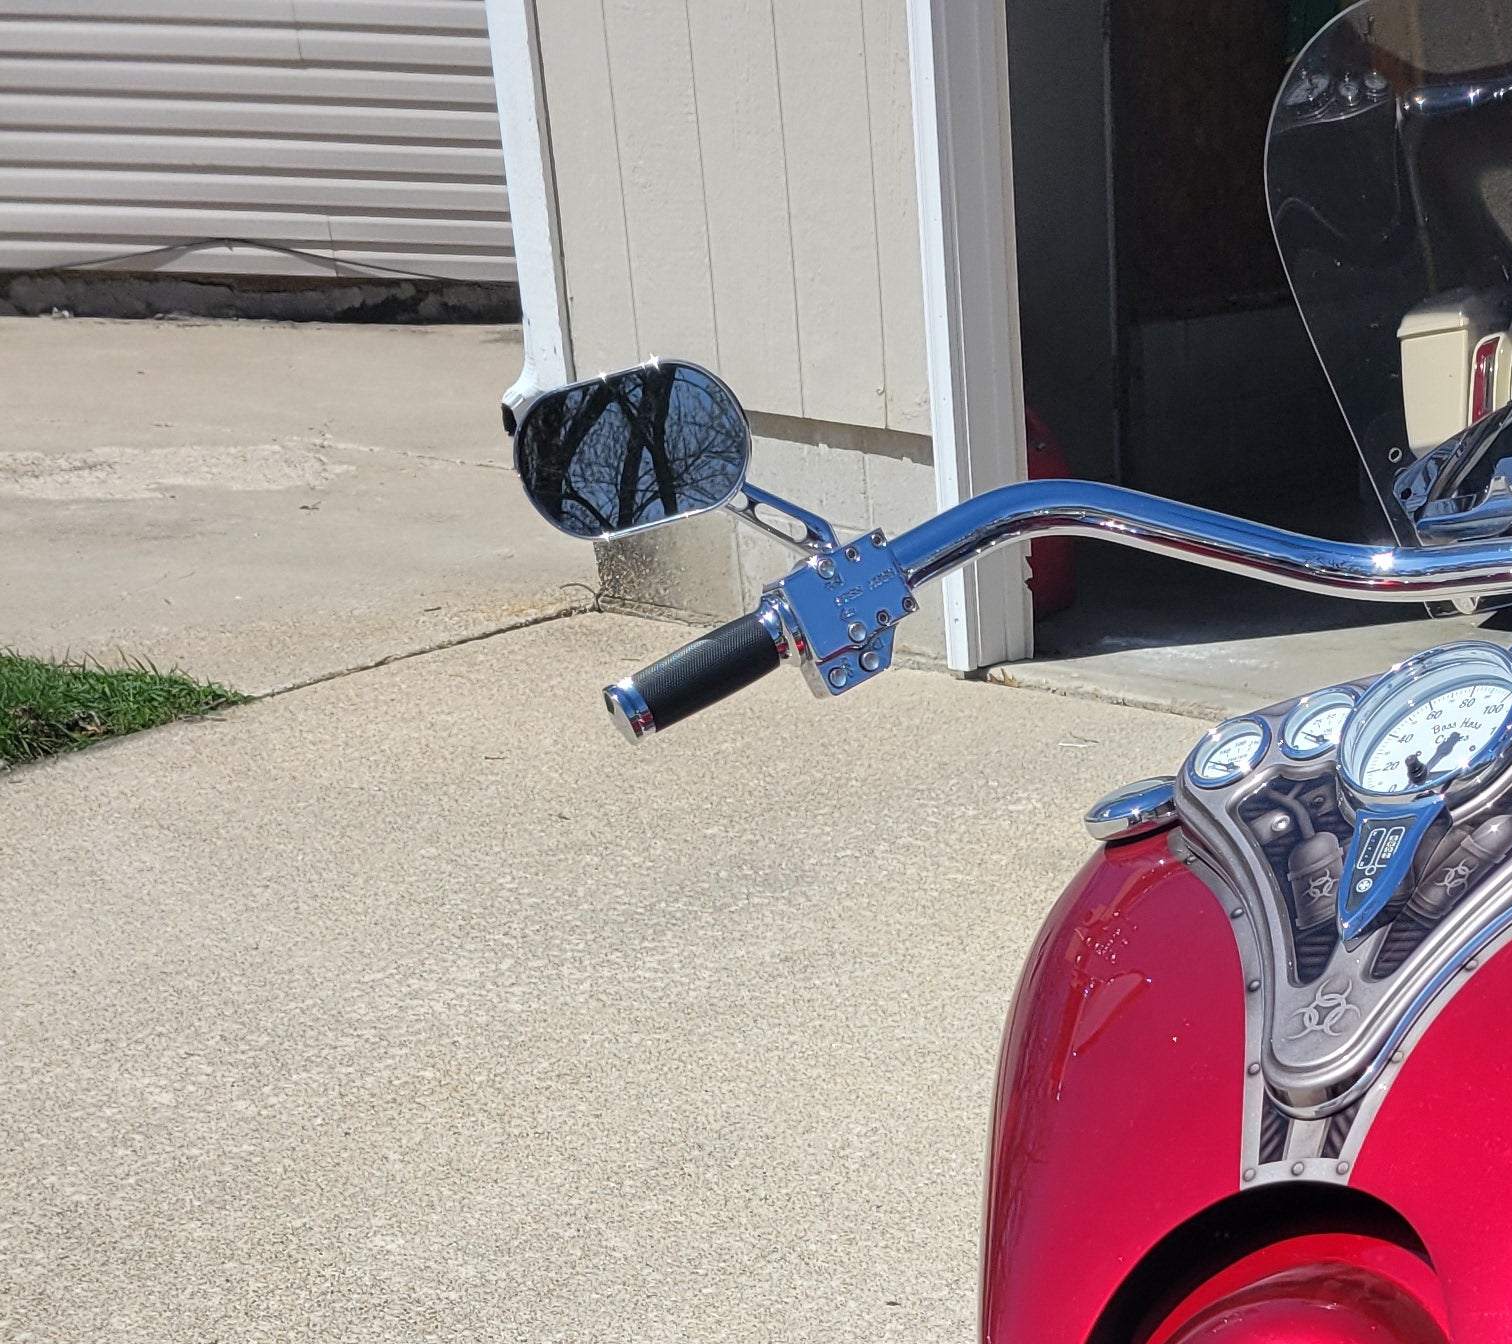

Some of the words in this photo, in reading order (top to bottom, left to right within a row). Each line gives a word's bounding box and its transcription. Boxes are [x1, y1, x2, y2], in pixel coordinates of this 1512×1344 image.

[1459, 697, 1476, 709] 80
[1482, 703, 1504, 715] 100
[1426, 709, 1443, 721] 60
[1397, 733, 1414, 744] 40
[1383, 761, 1400, 771] 20
